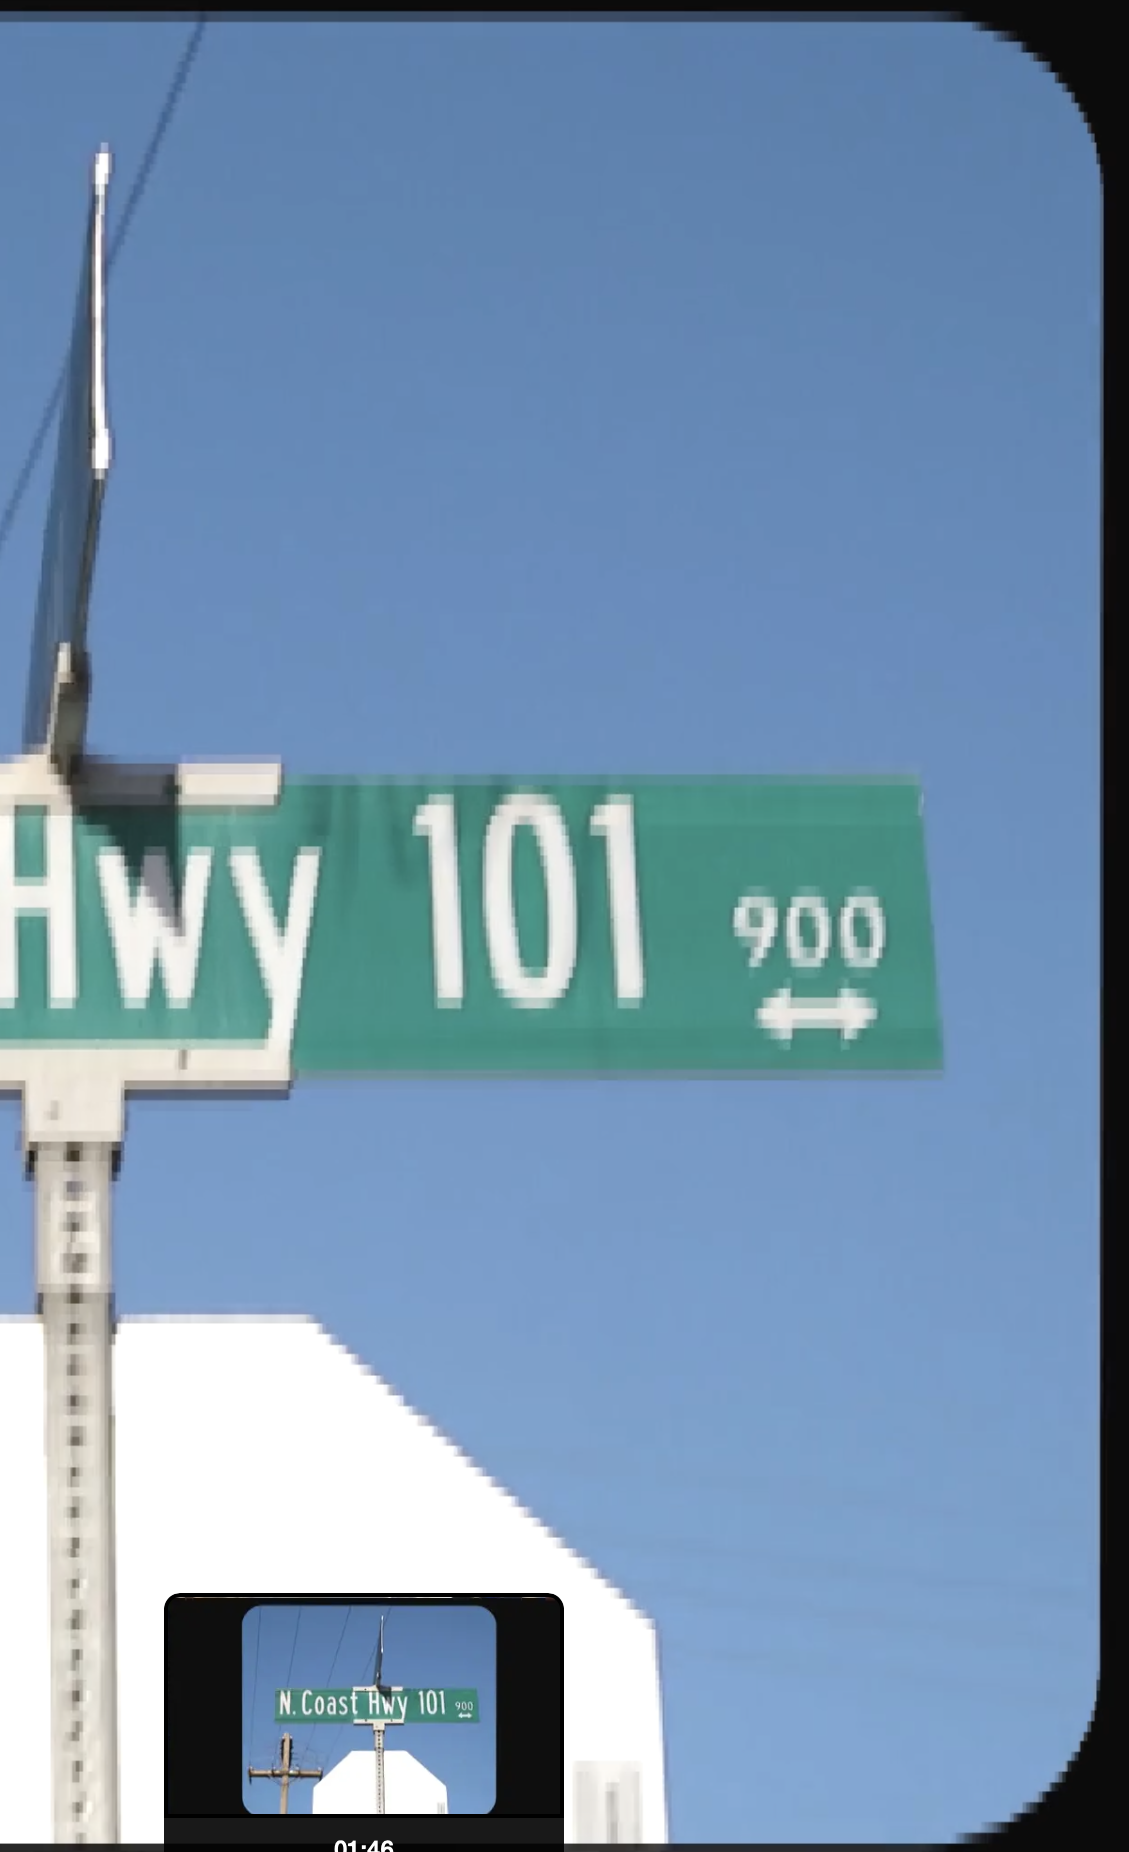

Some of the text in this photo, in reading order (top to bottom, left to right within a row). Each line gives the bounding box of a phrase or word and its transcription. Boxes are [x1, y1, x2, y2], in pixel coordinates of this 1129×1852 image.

[413, 793, 645, 1009] 101
[732, 886, 887, 973] 900
[279, 1689, 446, 1720] N. Coast Hwy 101
[455, 1701, 473, 1711] 900
